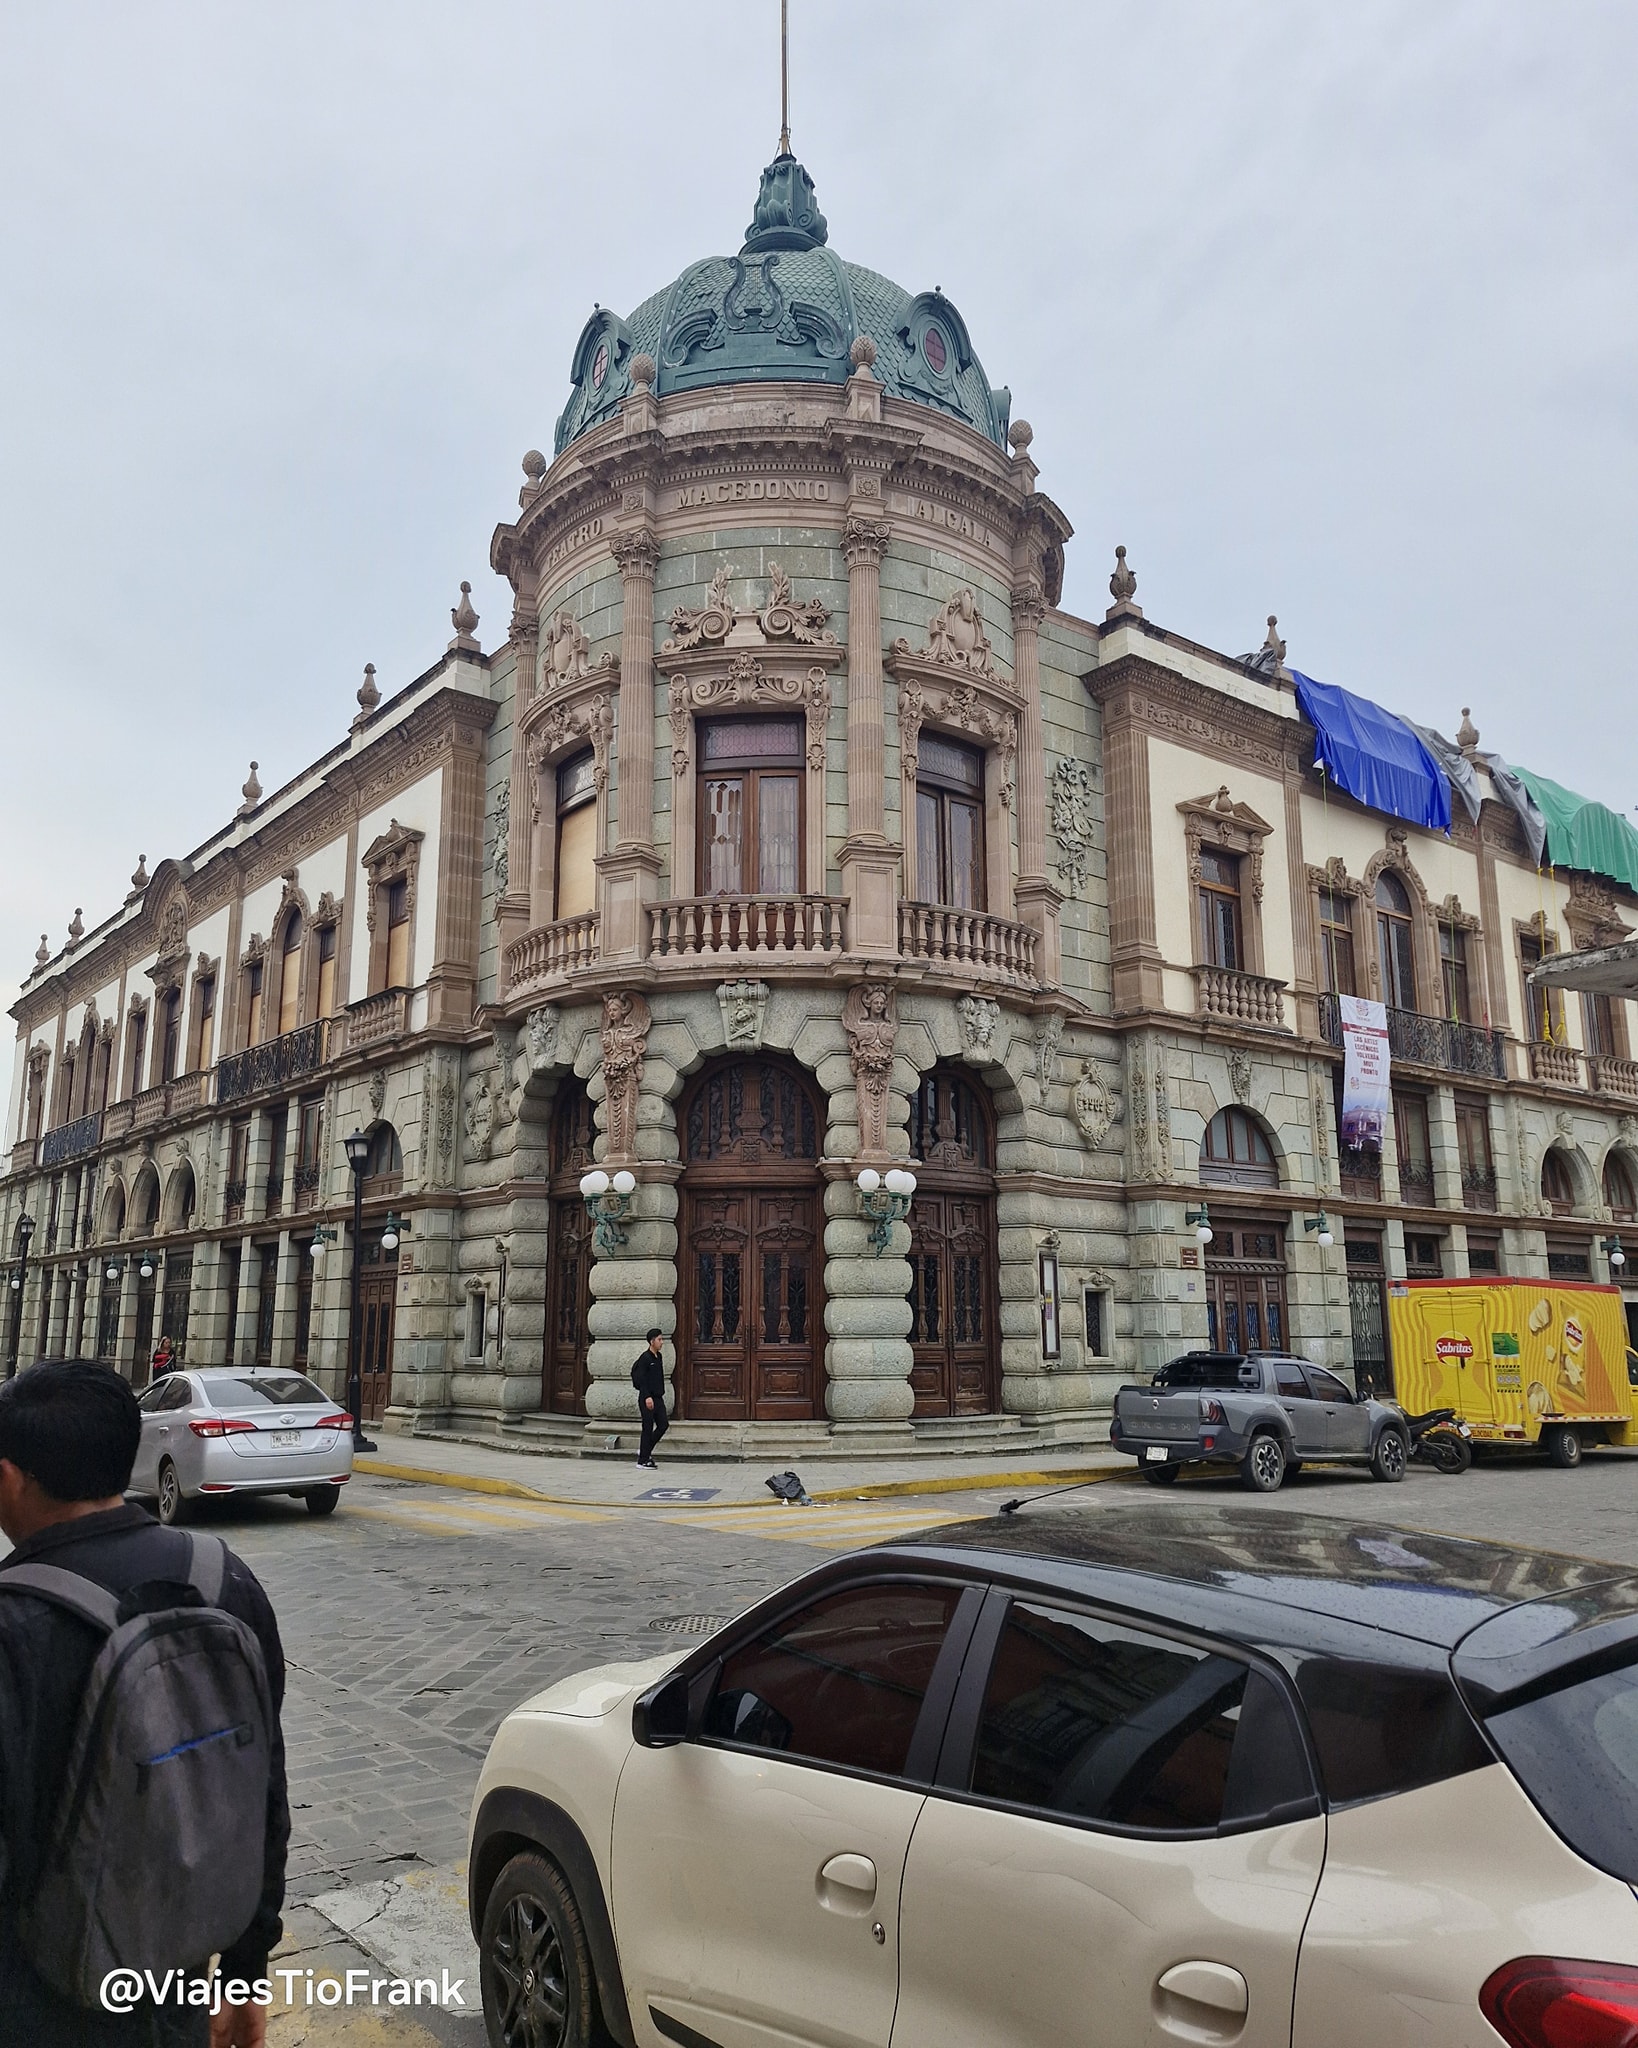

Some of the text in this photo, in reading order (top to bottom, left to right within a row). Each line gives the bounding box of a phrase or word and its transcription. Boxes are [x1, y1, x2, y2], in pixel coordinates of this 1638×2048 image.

[546, 518, 602, 568] TEATRO
[676, 479, 829, 509] MACEDONIO
[1436, 1341, 1473, 1354] Sabritas
